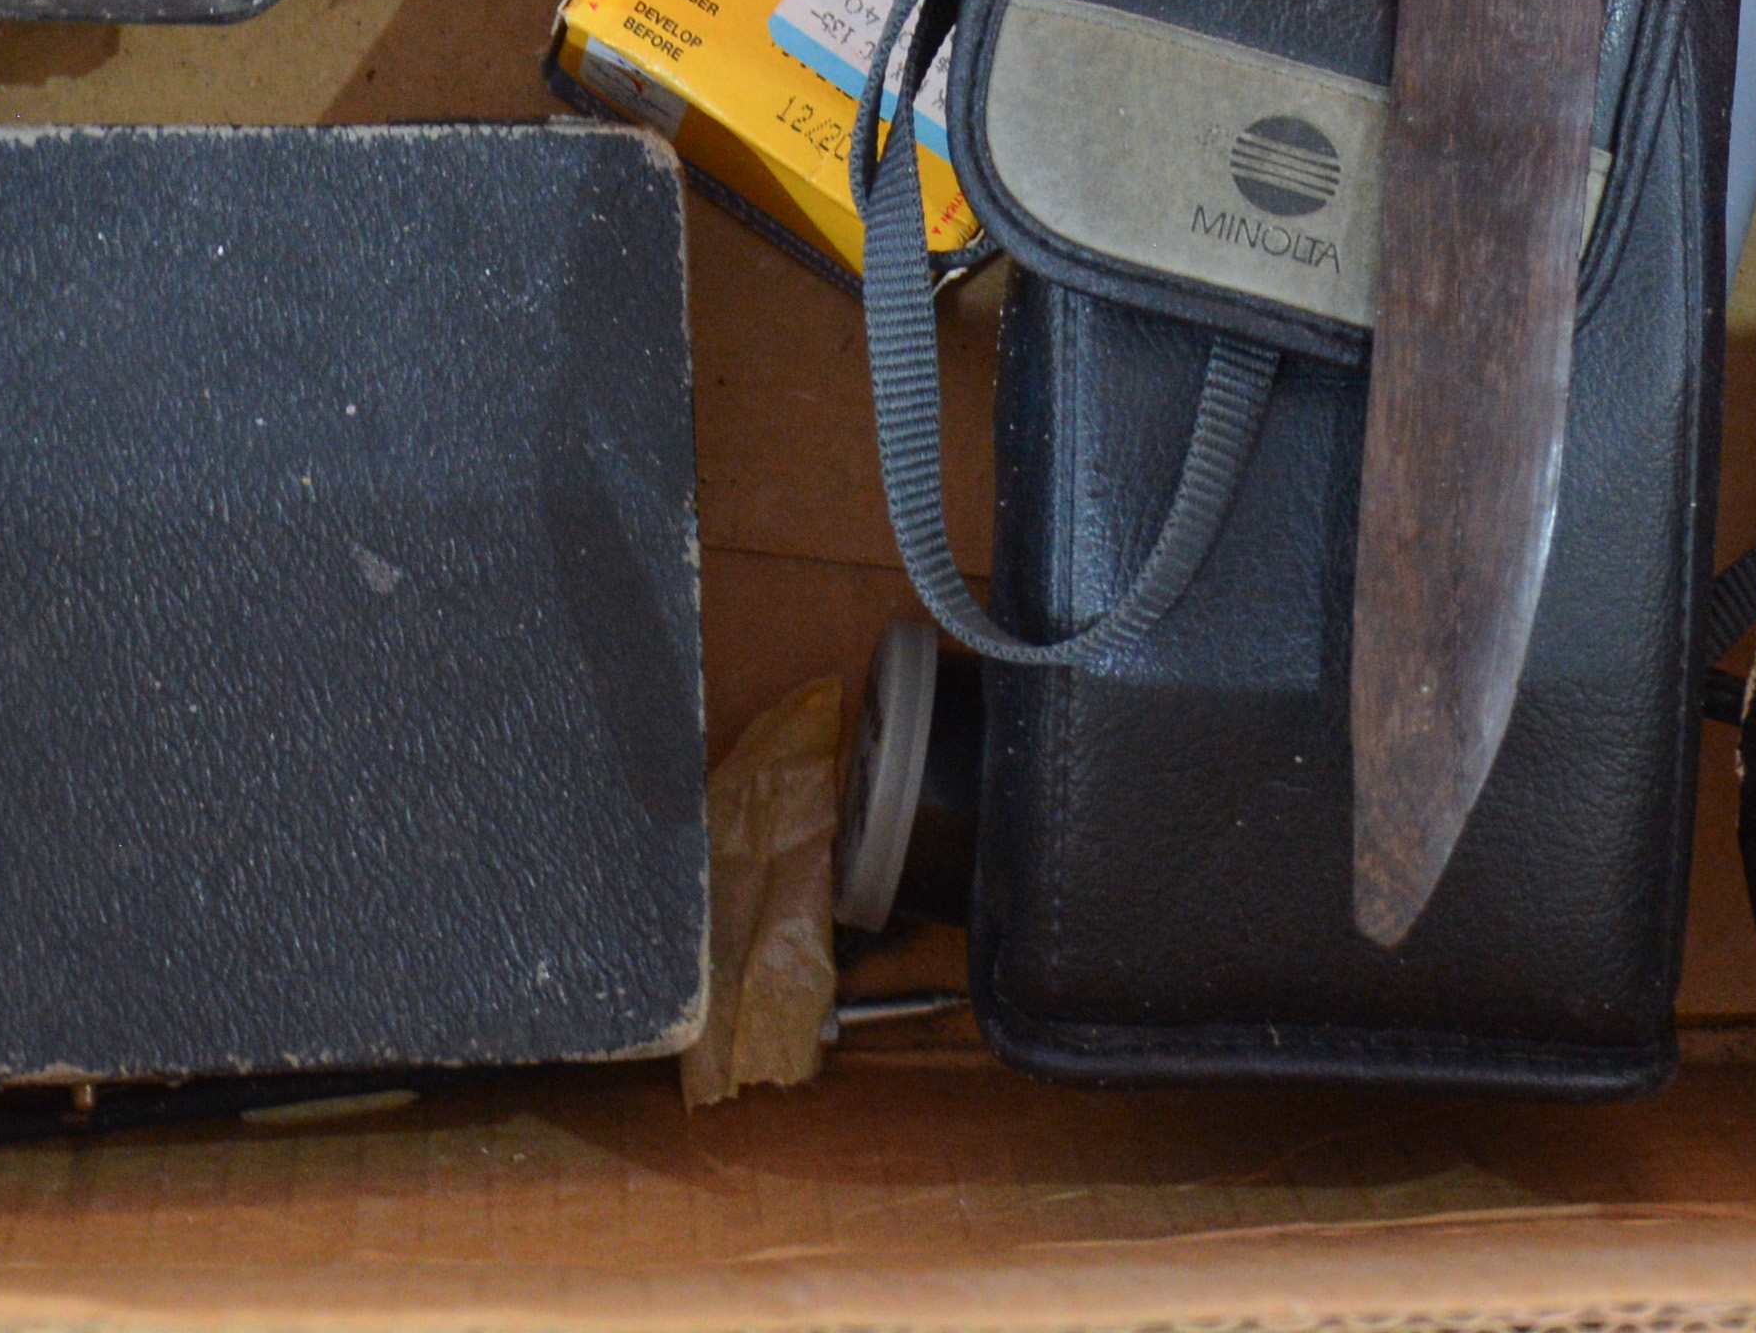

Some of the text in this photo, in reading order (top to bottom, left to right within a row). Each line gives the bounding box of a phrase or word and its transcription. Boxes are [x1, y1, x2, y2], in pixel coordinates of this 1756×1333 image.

[623, 15, 685, 64] BEFORE
[633, 0, 704, 52] DEVELOP
[1191, 203, 1341, 274] MINOLTA
